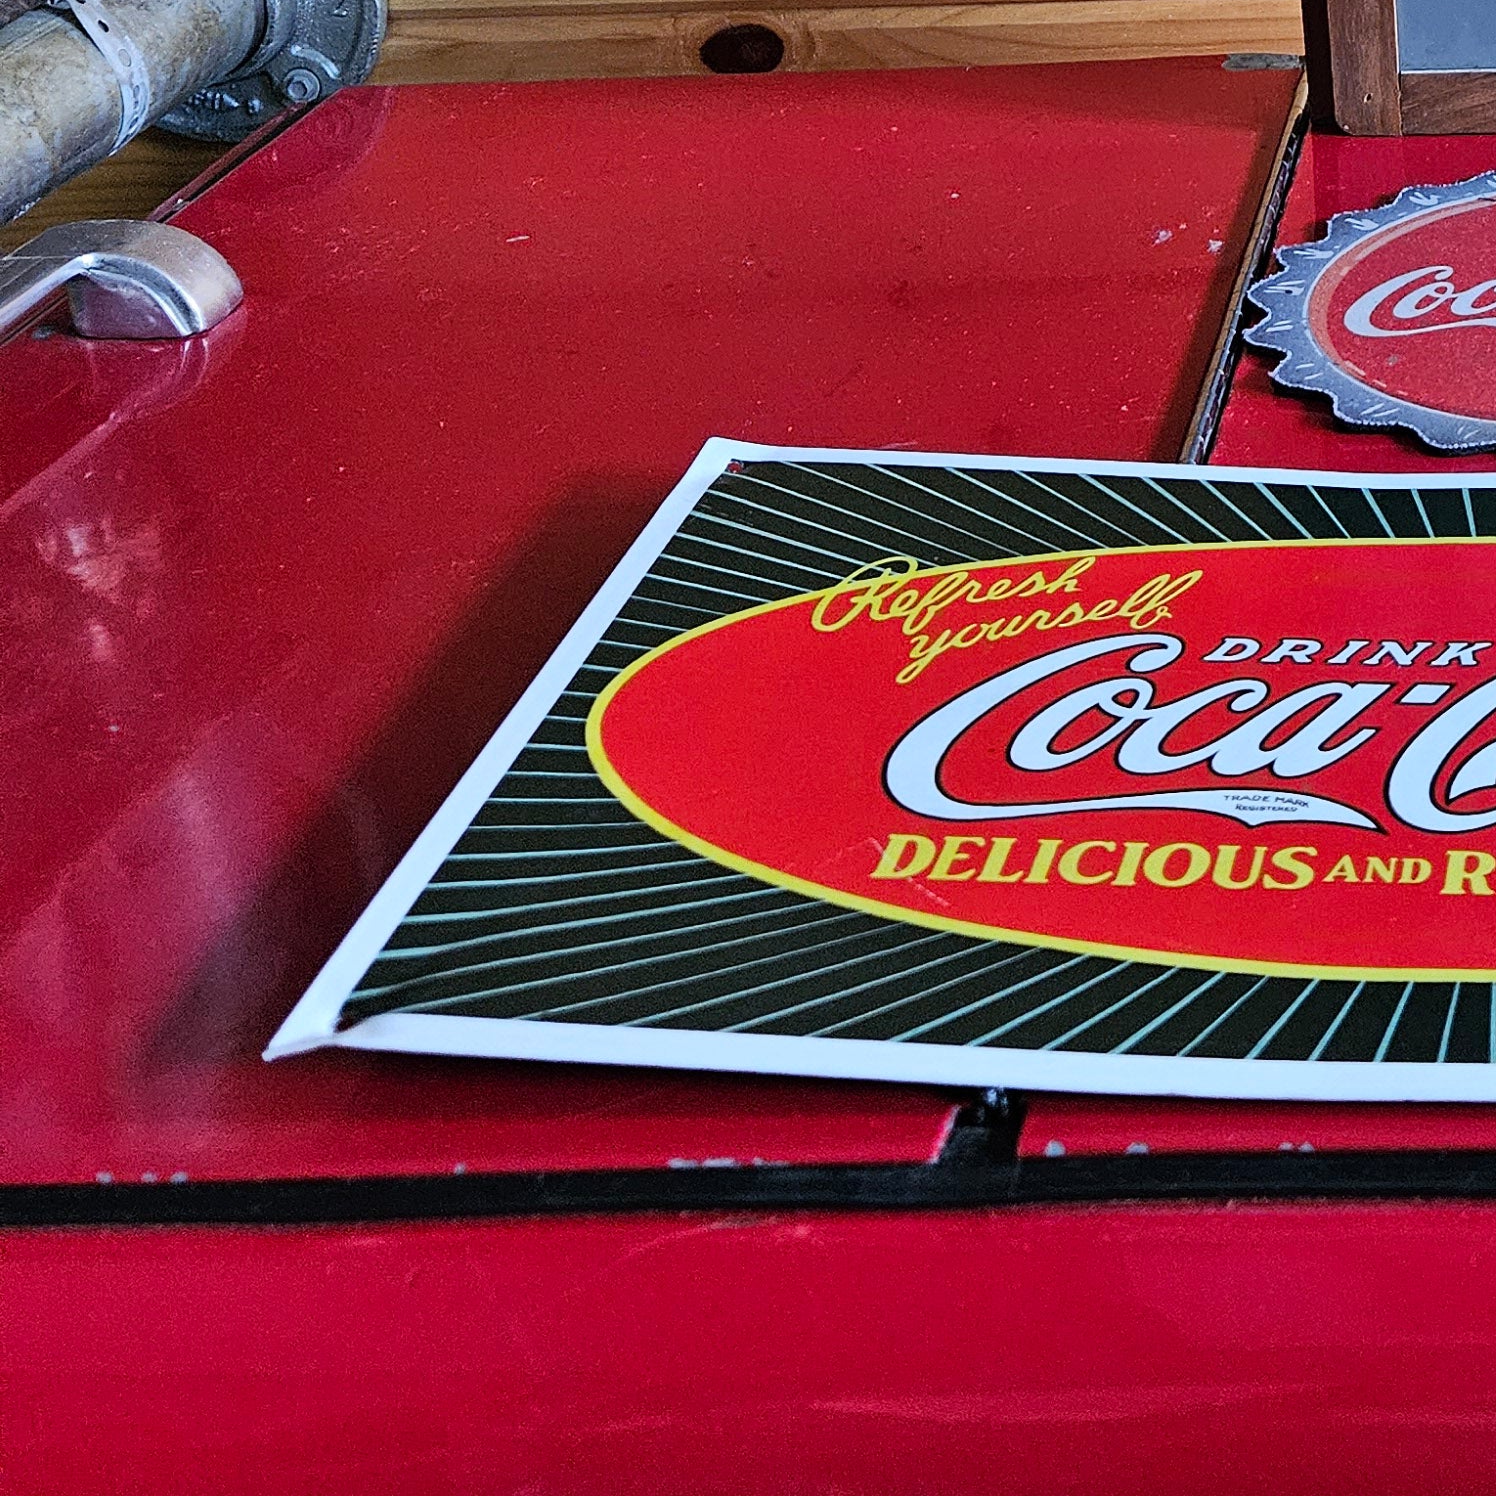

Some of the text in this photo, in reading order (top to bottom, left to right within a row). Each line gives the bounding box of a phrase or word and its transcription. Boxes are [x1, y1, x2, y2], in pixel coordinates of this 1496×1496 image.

[810, 555, 1097, 633] Refresh
[895, 569, 1204, 685] yourself
[1203, 636, 1493, 667] DRINK
[869, 832, 1319, 891] DELICIOUS
[1321, 856, 1433, 885] AND
